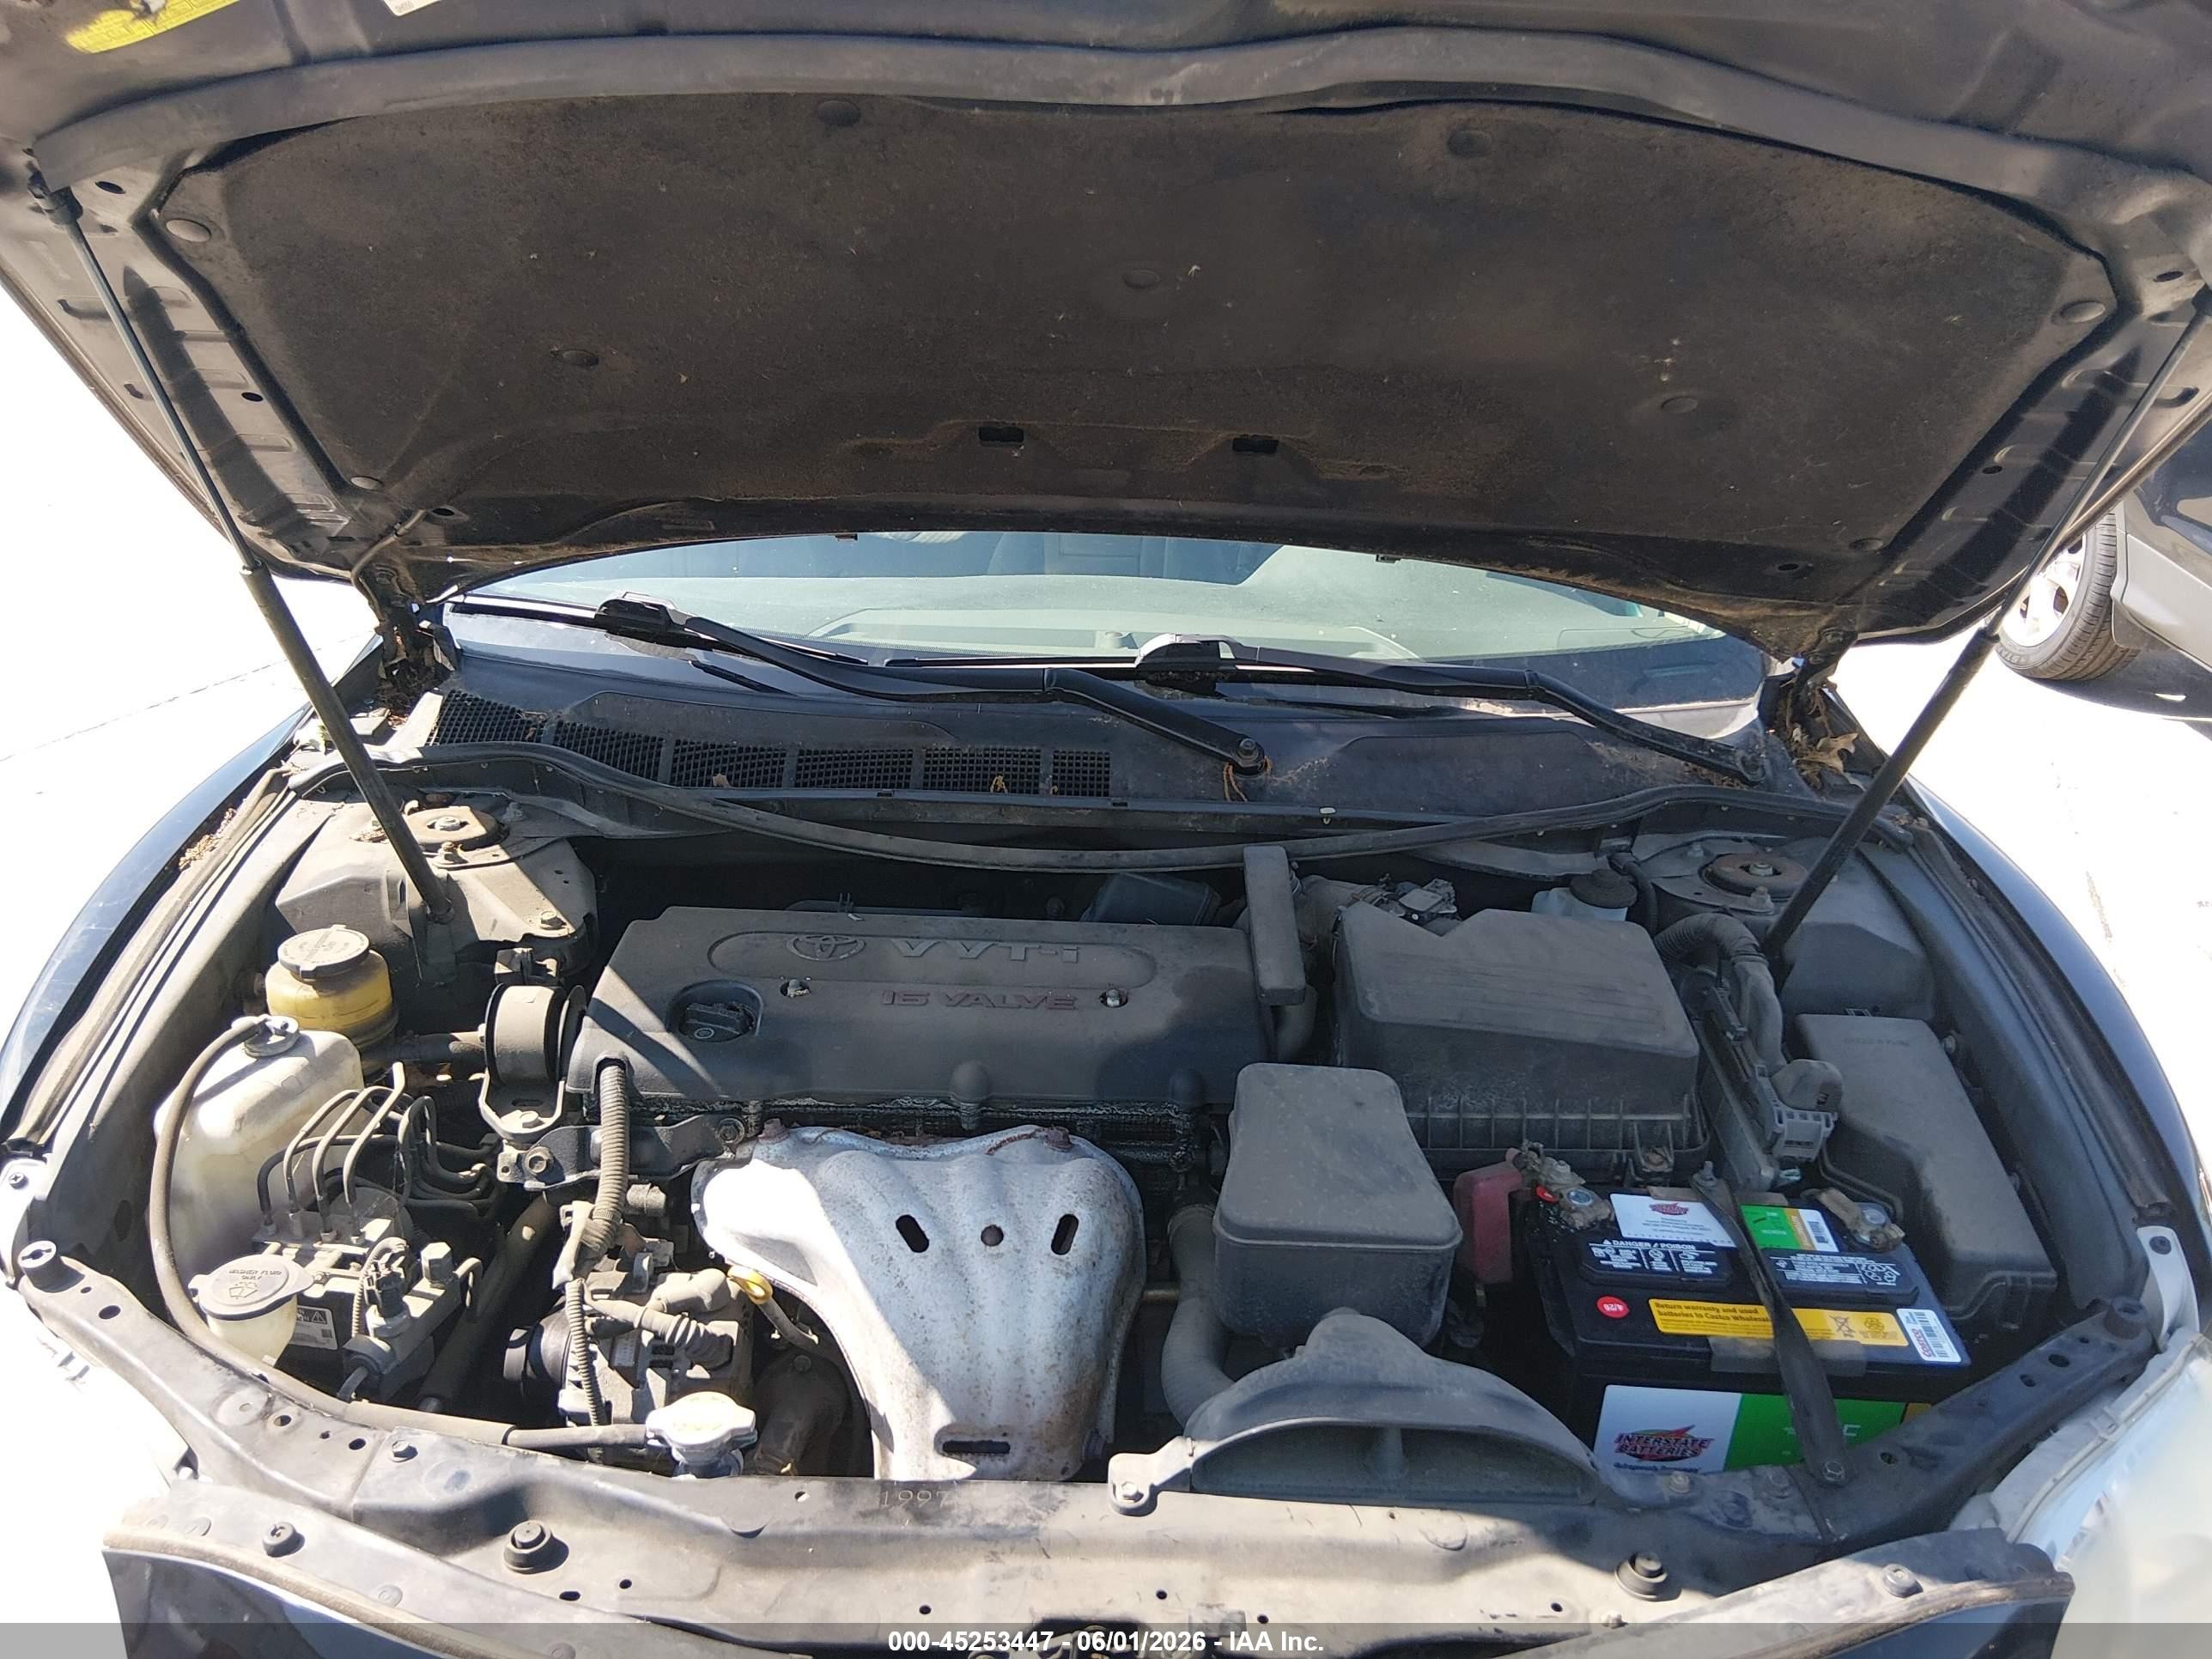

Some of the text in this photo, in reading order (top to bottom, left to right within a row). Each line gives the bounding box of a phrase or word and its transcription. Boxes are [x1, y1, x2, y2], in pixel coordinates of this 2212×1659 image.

[892, 939, 1079, 963] VVT-i
[883, 991, 1079, 1011] 16 VALVE
[1612, 1239, 1651, 1249] DANGER
[1911, 1328, 1932, 1358] COSTCO
[1614, 1433, 1711, 1449] INTERSTATE
[1616, 1444, 1701, 1457] BATTERIES
